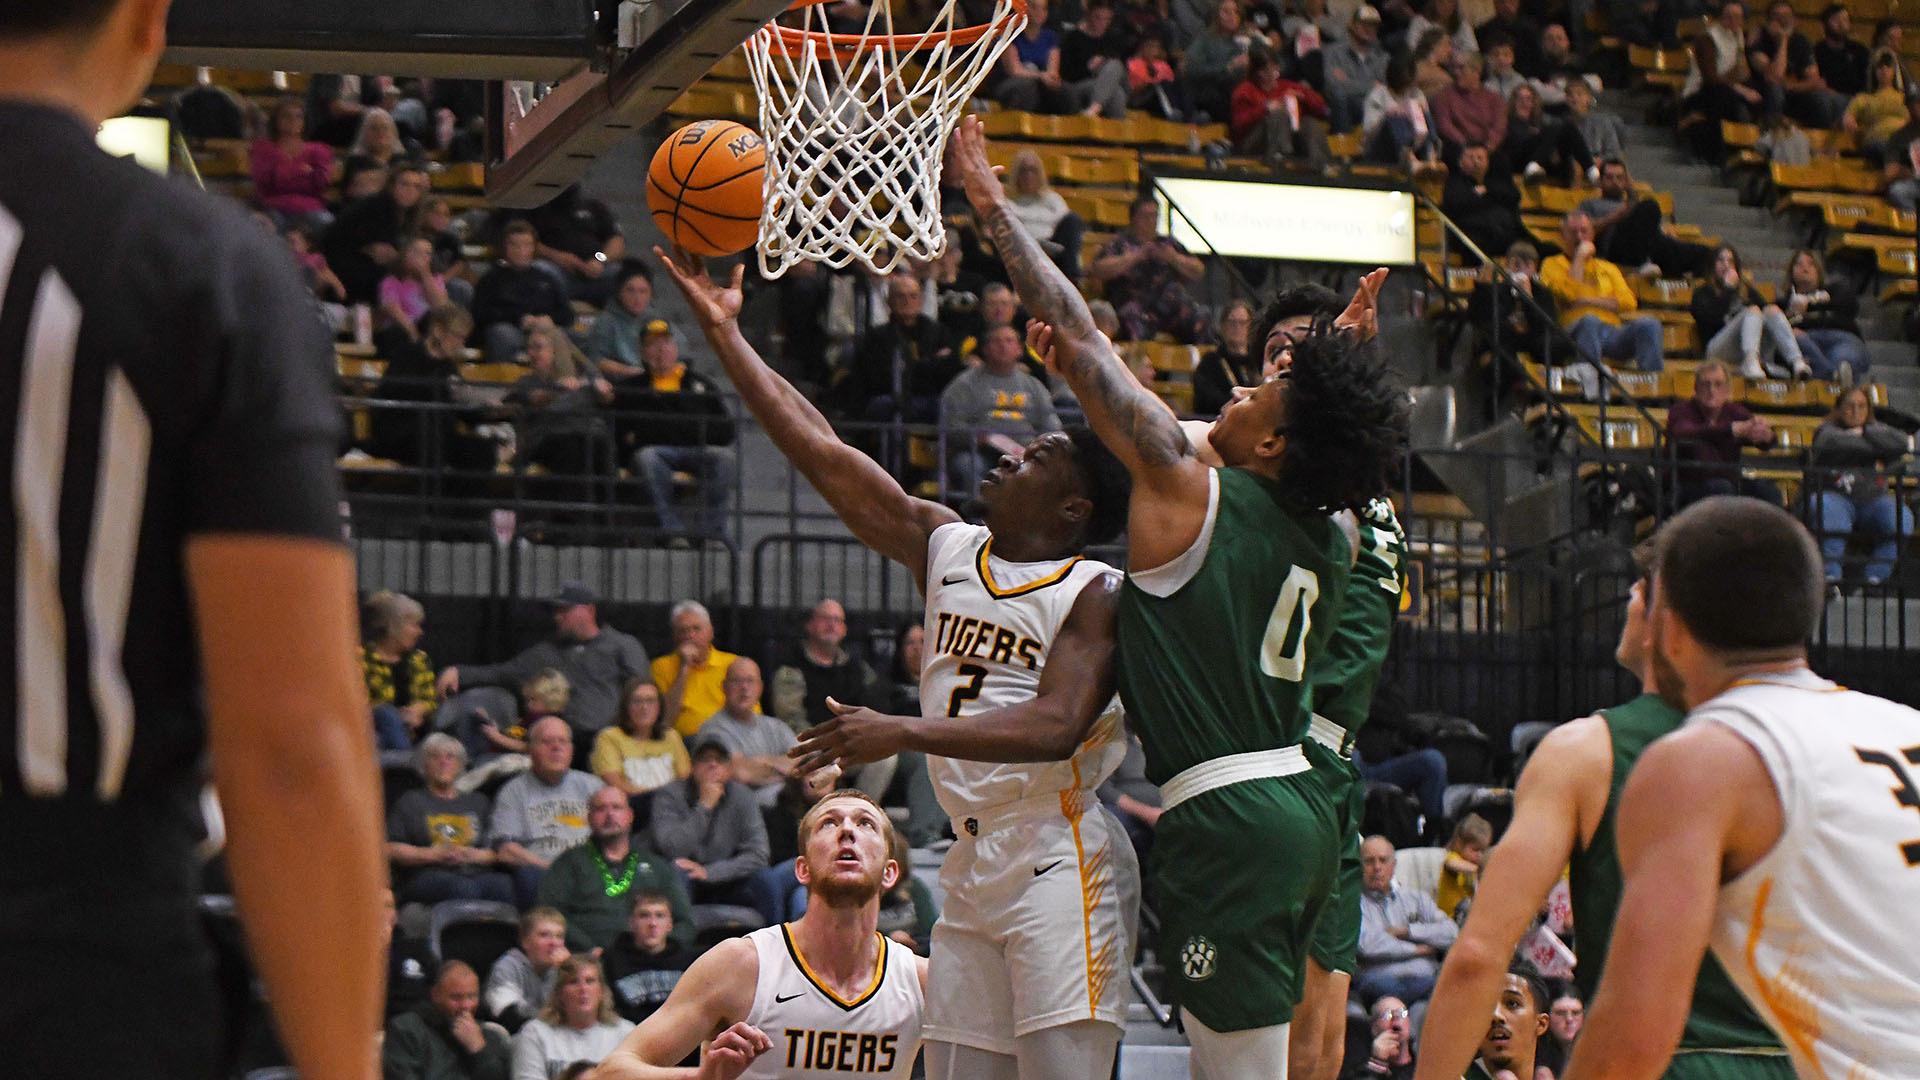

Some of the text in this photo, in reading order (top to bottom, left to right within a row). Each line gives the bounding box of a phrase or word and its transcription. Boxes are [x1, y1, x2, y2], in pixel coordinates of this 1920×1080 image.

[1211, 208, 1294, 231] Midwest
[1371, 526, 1400, 594] 5
[935, 612, 1042, 671] TIGERS
[1260, 563, 1320, 682] 0
[947, 662, 989, 718] 2
[784, 1028, 899, 1073] TIGERS
